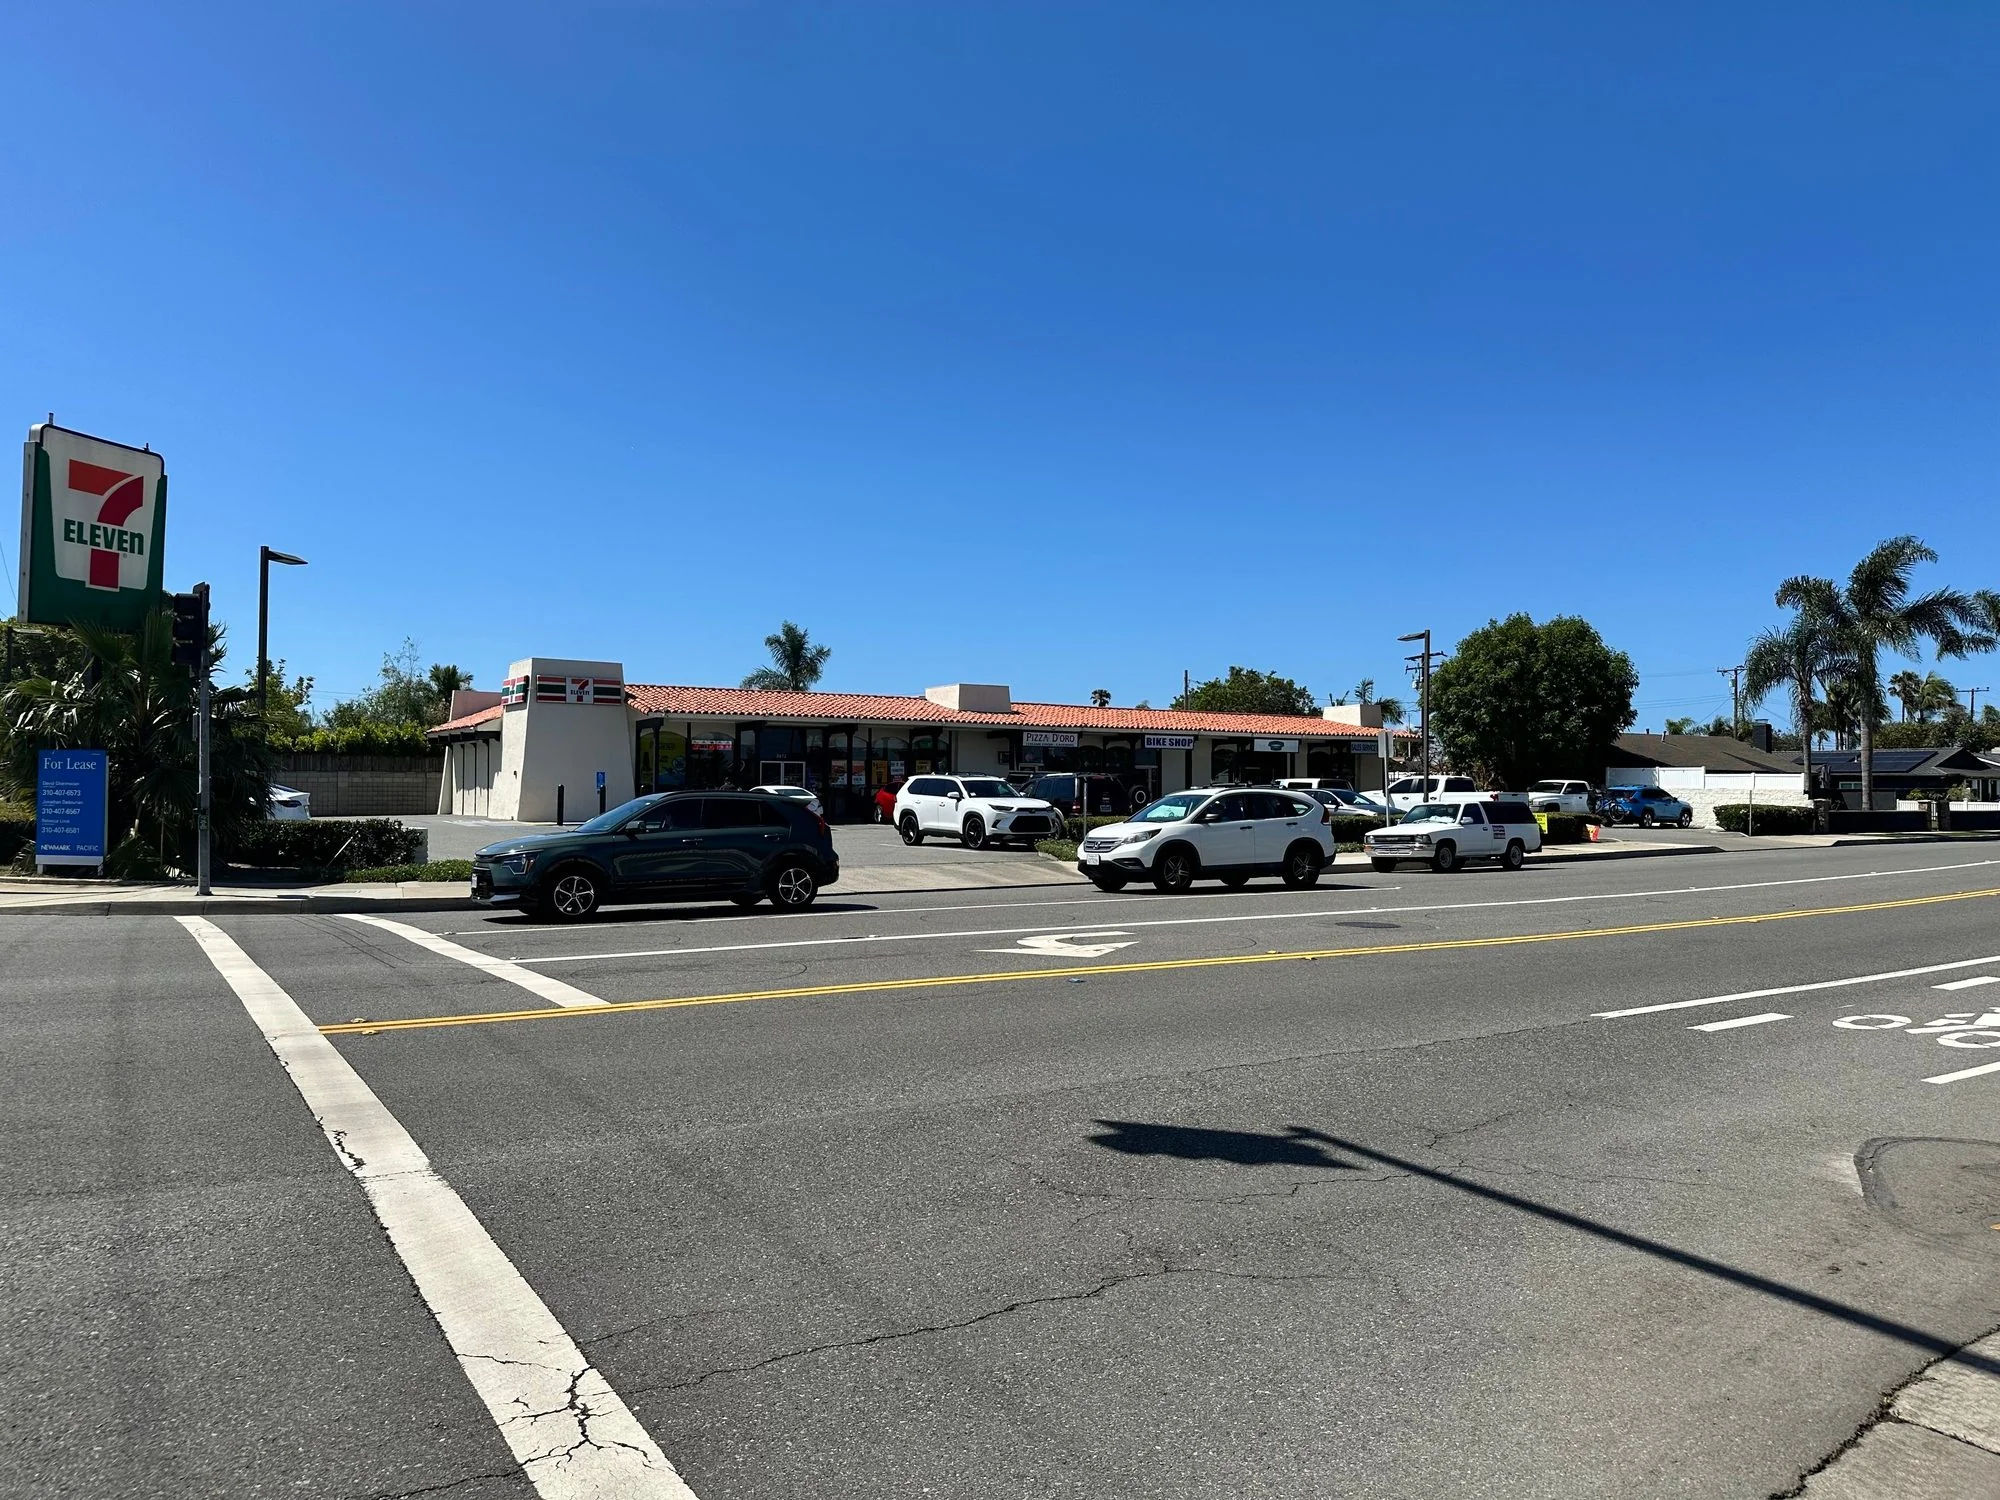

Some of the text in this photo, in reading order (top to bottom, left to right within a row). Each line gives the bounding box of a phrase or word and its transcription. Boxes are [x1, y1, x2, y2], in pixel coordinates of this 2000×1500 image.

[68, 459, 144, 589] 7
[571, 678, 589, 702] 7
[1146, 738, 1193, 747] BIKE SHOP
[44, 758, 97, 770] For Lease
[76, 844, 99, 852] PACIFIC
